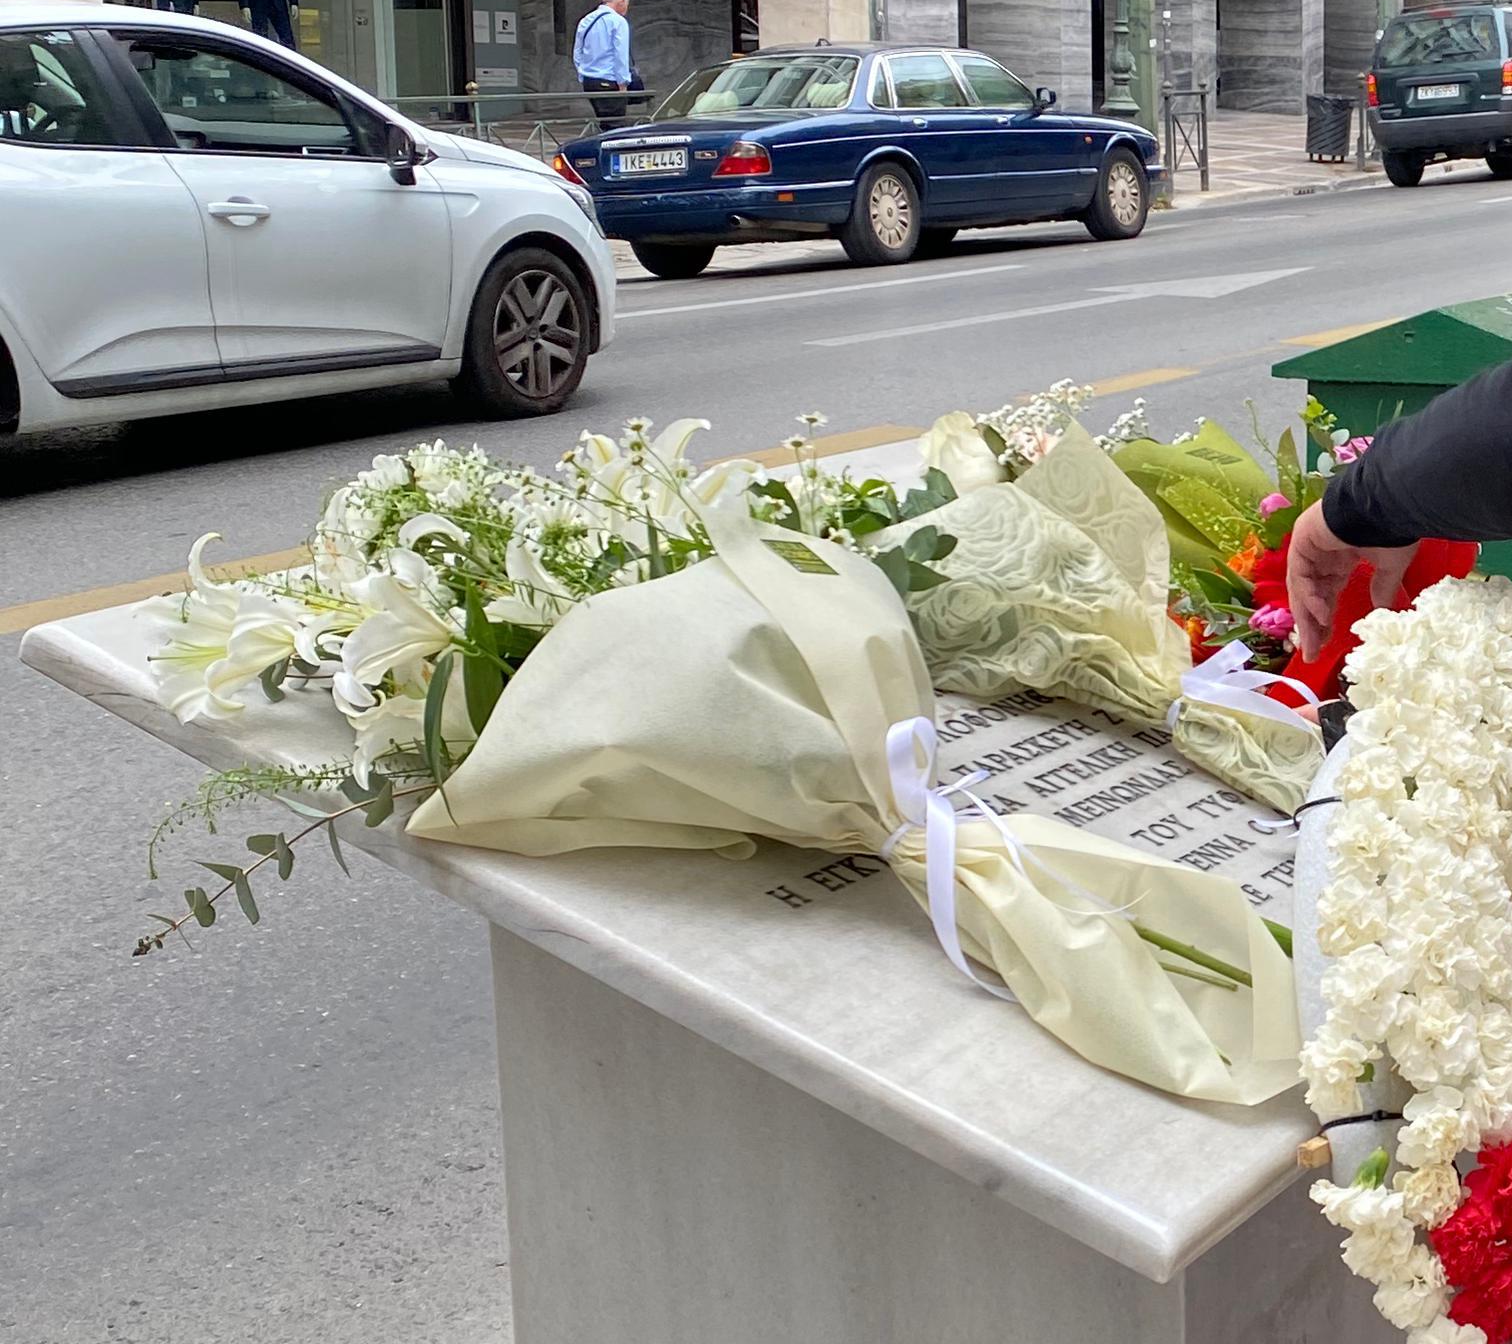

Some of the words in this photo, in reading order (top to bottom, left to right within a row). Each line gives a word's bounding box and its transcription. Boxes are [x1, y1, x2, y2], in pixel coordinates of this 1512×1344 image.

[765, 885, 813, 908] Η
[1023, 741, 1145, 797] ΑΓΓΕΛΙΚΗ
[1130, 814, 1194, 847] ΤΟΥ
[1173, 834, 1256, 871] ΕΝΝΑ
